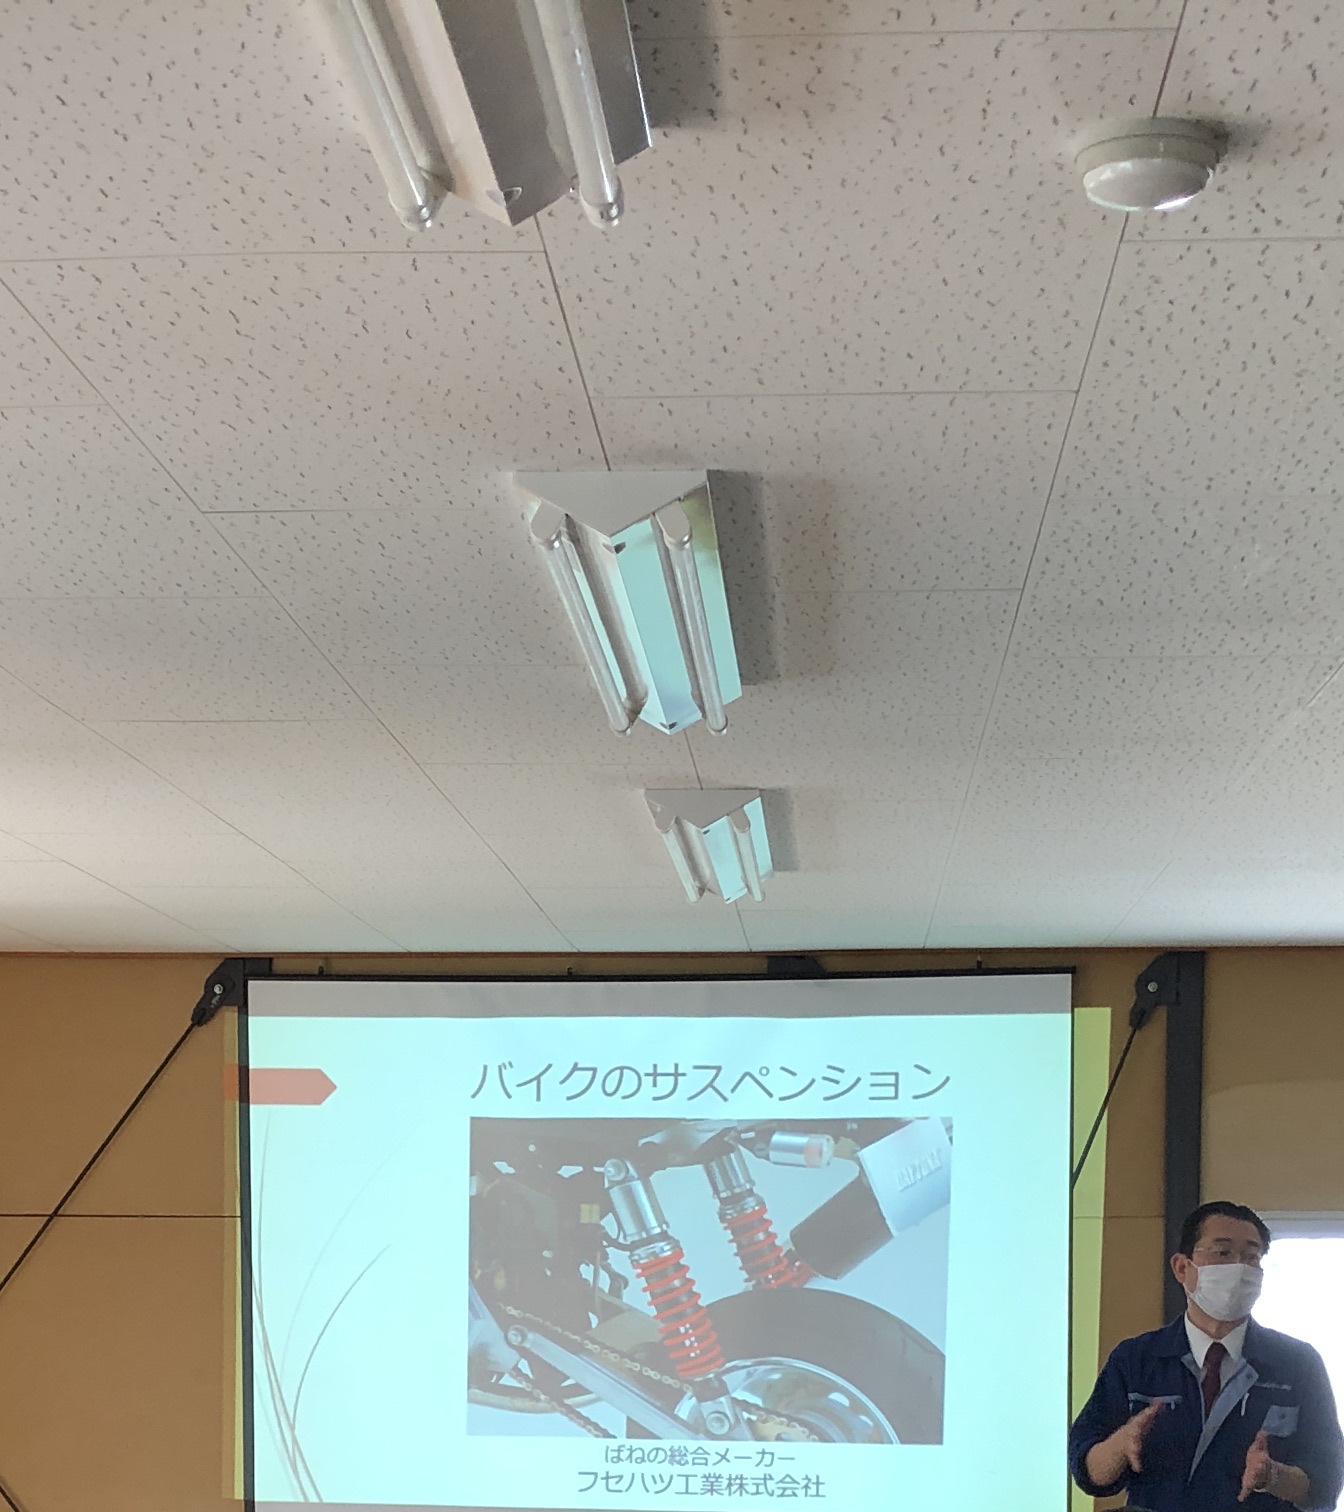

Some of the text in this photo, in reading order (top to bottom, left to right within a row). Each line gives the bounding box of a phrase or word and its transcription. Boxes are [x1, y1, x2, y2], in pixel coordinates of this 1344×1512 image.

[470, 1060, 952, 1103] バイクのサスペンション
[605, 1444, 796, 1468] ばねの総合メーカー
[577, 1470, 826, 1498] フセハツ工業株式会社
